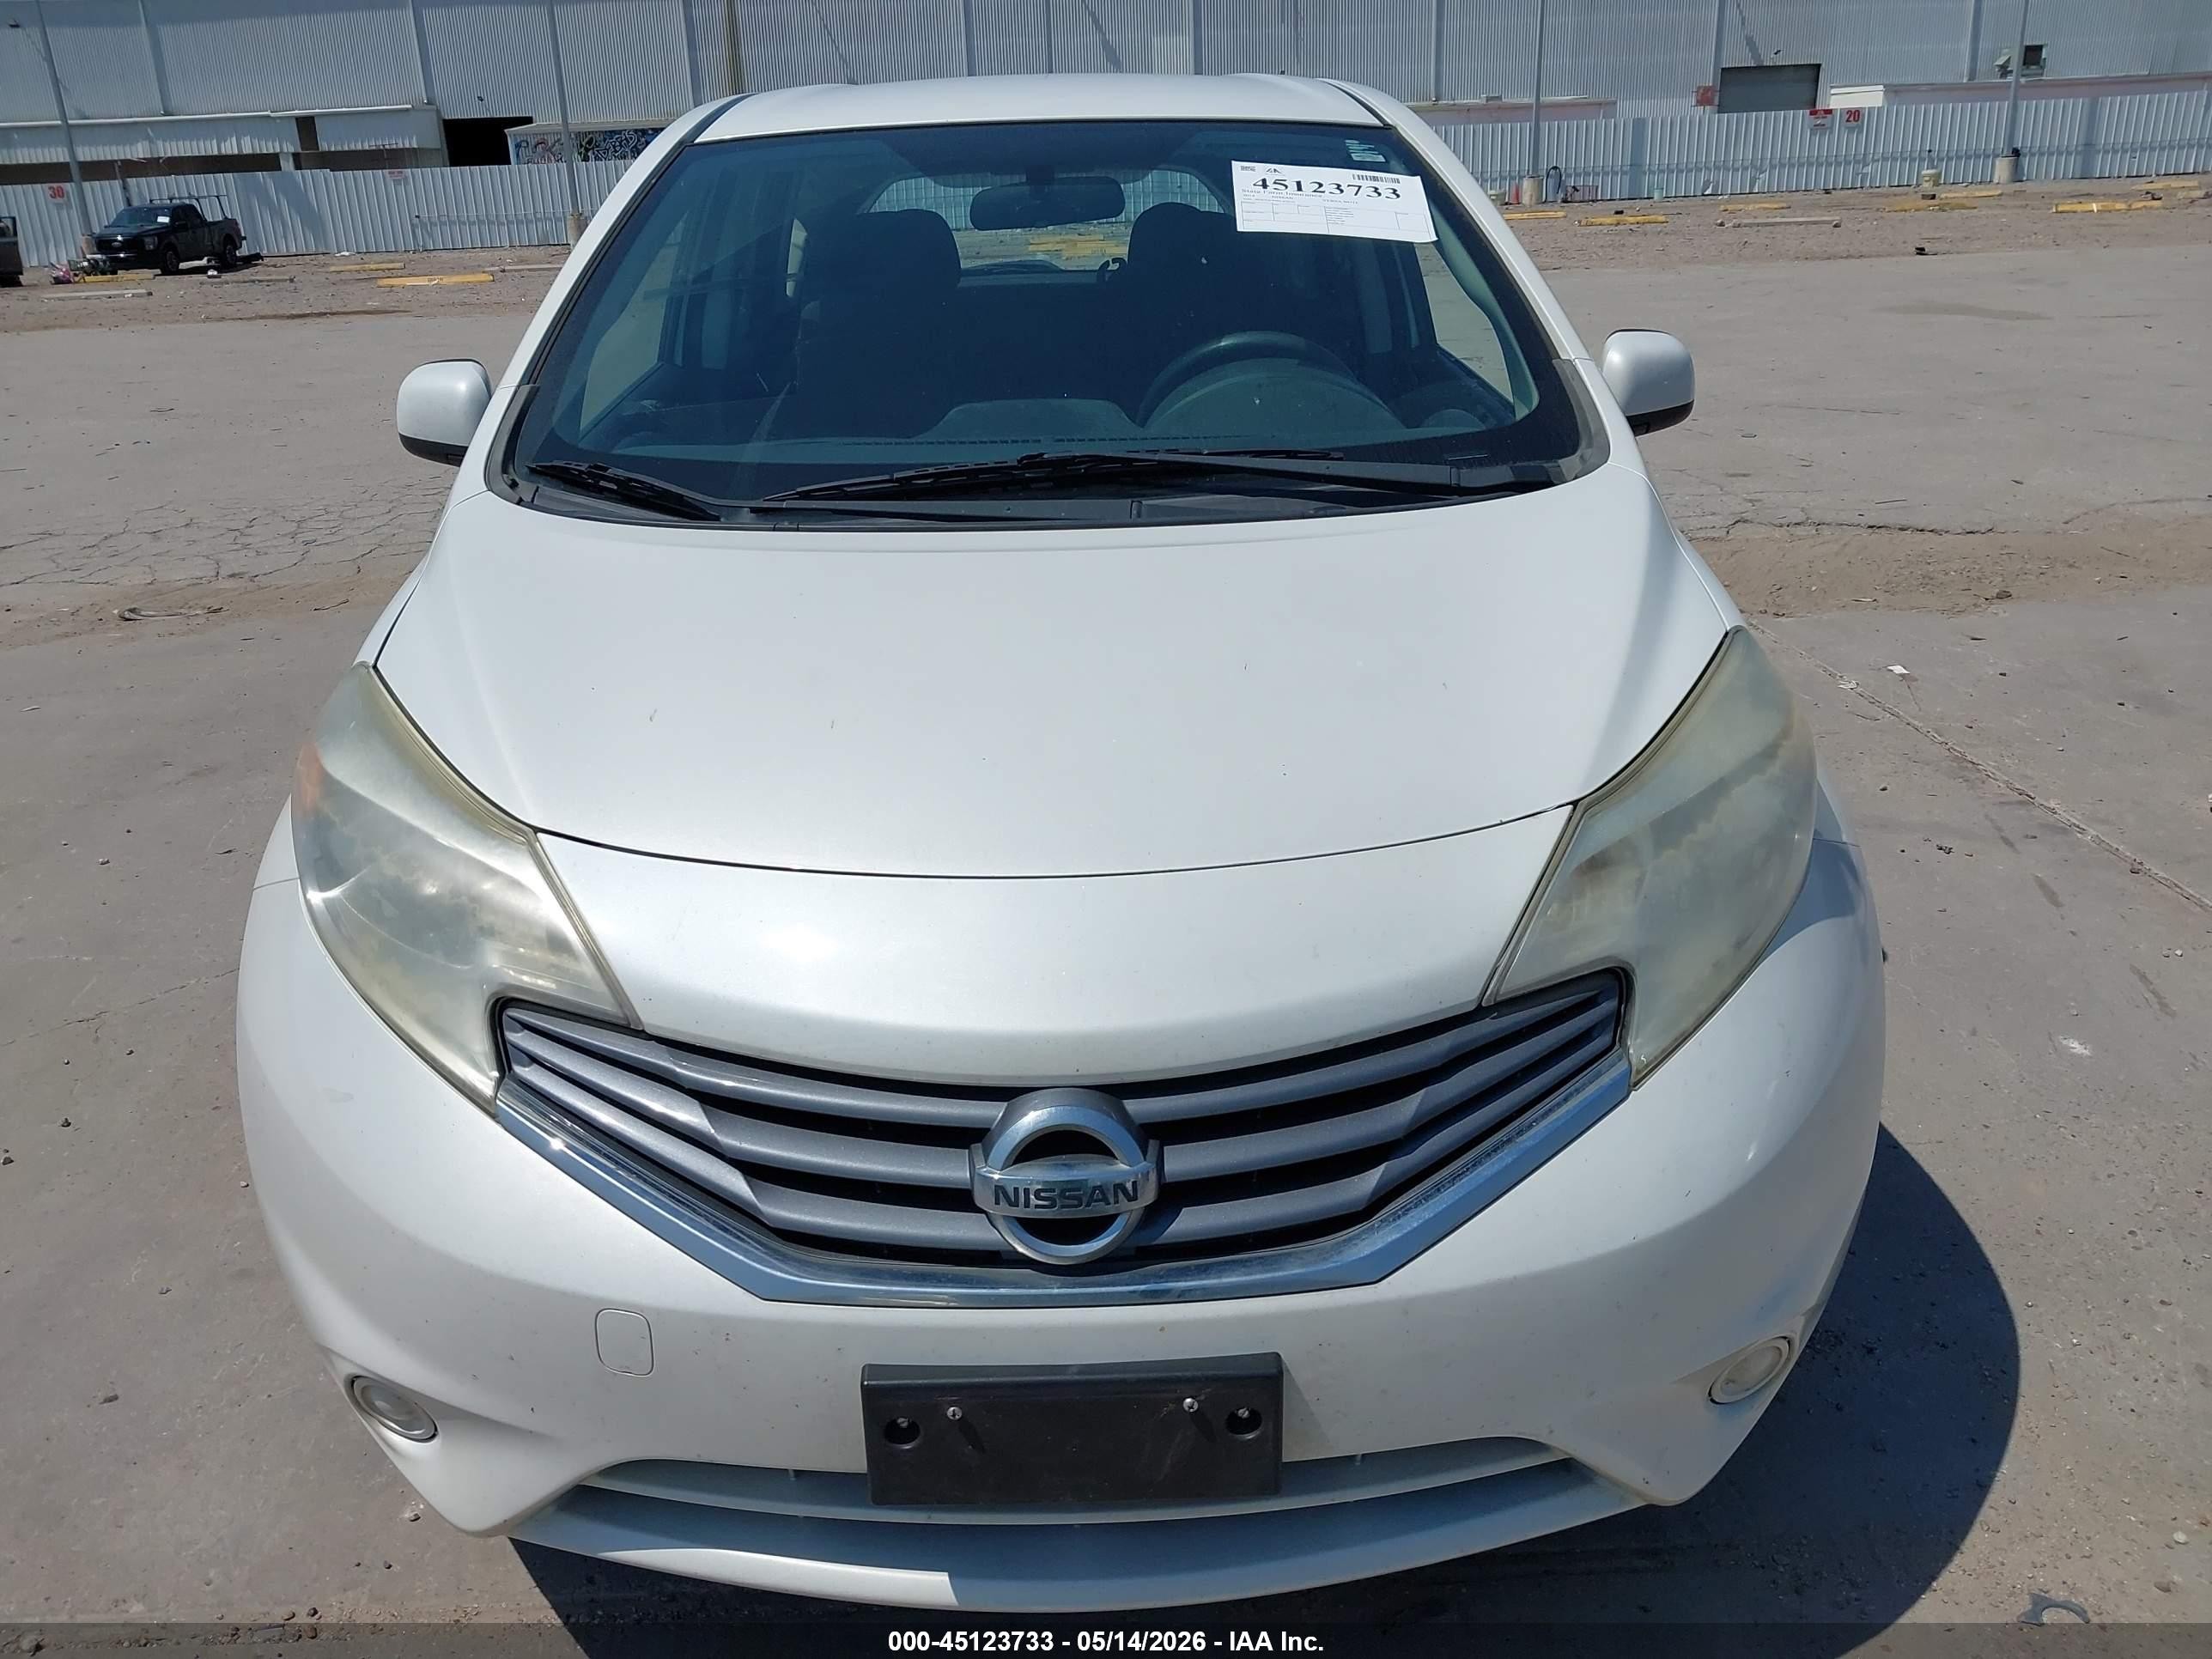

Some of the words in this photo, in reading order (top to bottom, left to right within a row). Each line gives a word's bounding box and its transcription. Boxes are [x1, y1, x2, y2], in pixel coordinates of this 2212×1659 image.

[1845, 109, 1861, 123] 20
[48, 185, 65, 199] 30
[1252, 177, 1401, 200] 45123733
[994, 1180, 1139, 1209] NISSAN
